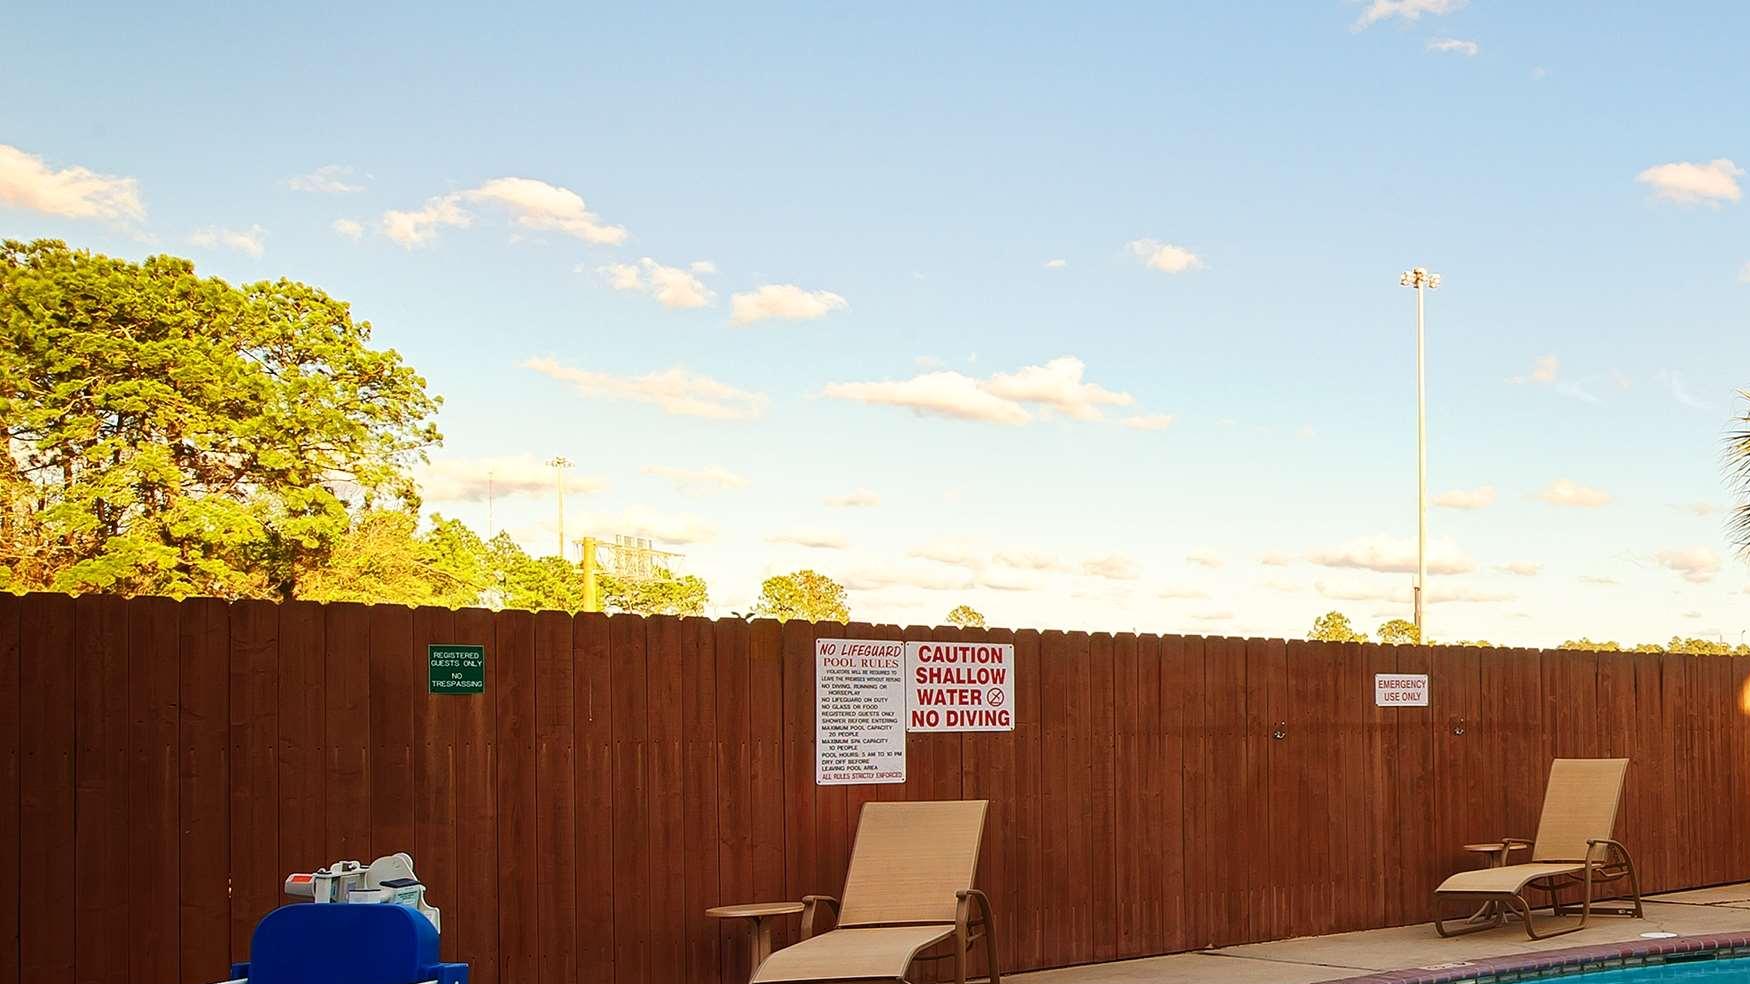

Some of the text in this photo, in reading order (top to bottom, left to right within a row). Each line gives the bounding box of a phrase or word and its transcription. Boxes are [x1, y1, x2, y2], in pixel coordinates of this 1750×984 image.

[820, 644, 901, 657] NO LIFEGUARD
[919, 646, 1002, 664] CAUTION
[824, 658, 899, 668] POOL RULES
[916, 668, 1006, 684] SHALLOW
[1378, 680, 1426, 688] EMERGENCY
[917, 689, 982, 705] WATER
[1384, 692, 1421, 701] USE ONLY
[912, 710, 1010, 727] NO DIVING
